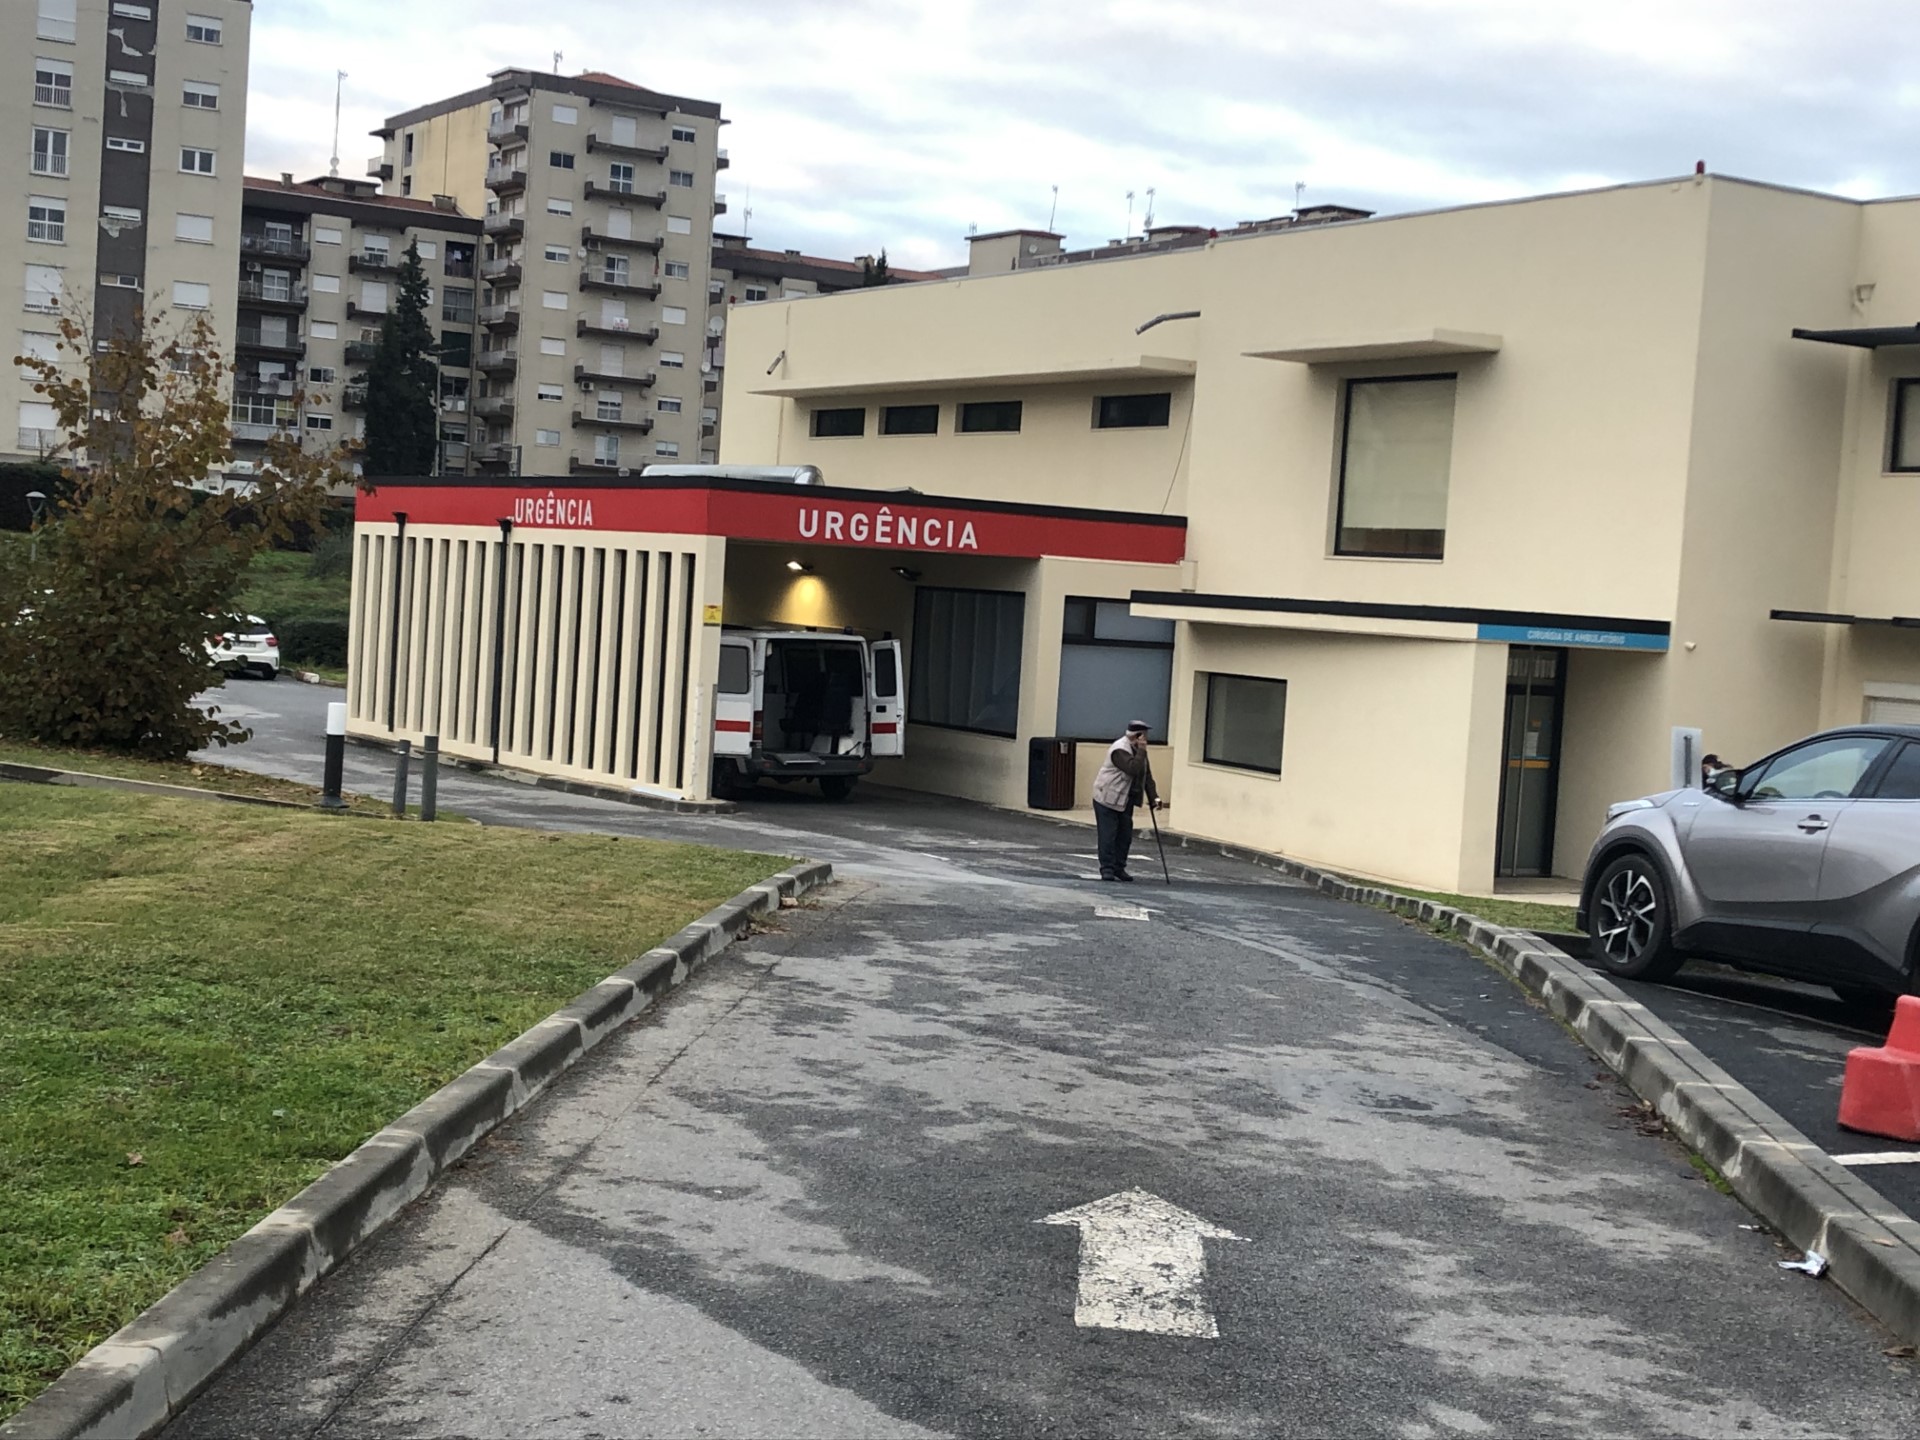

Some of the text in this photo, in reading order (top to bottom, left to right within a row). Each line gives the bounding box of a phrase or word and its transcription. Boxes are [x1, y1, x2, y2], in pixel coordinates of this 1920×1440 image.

[515, 490, 593, 526] URGÊNCIA
[799, 506, 978, 549] URGÊNCIA
[1527, 630, 1562, 641] CIRURGIA
[1563, 632, 1573, 641] DE
